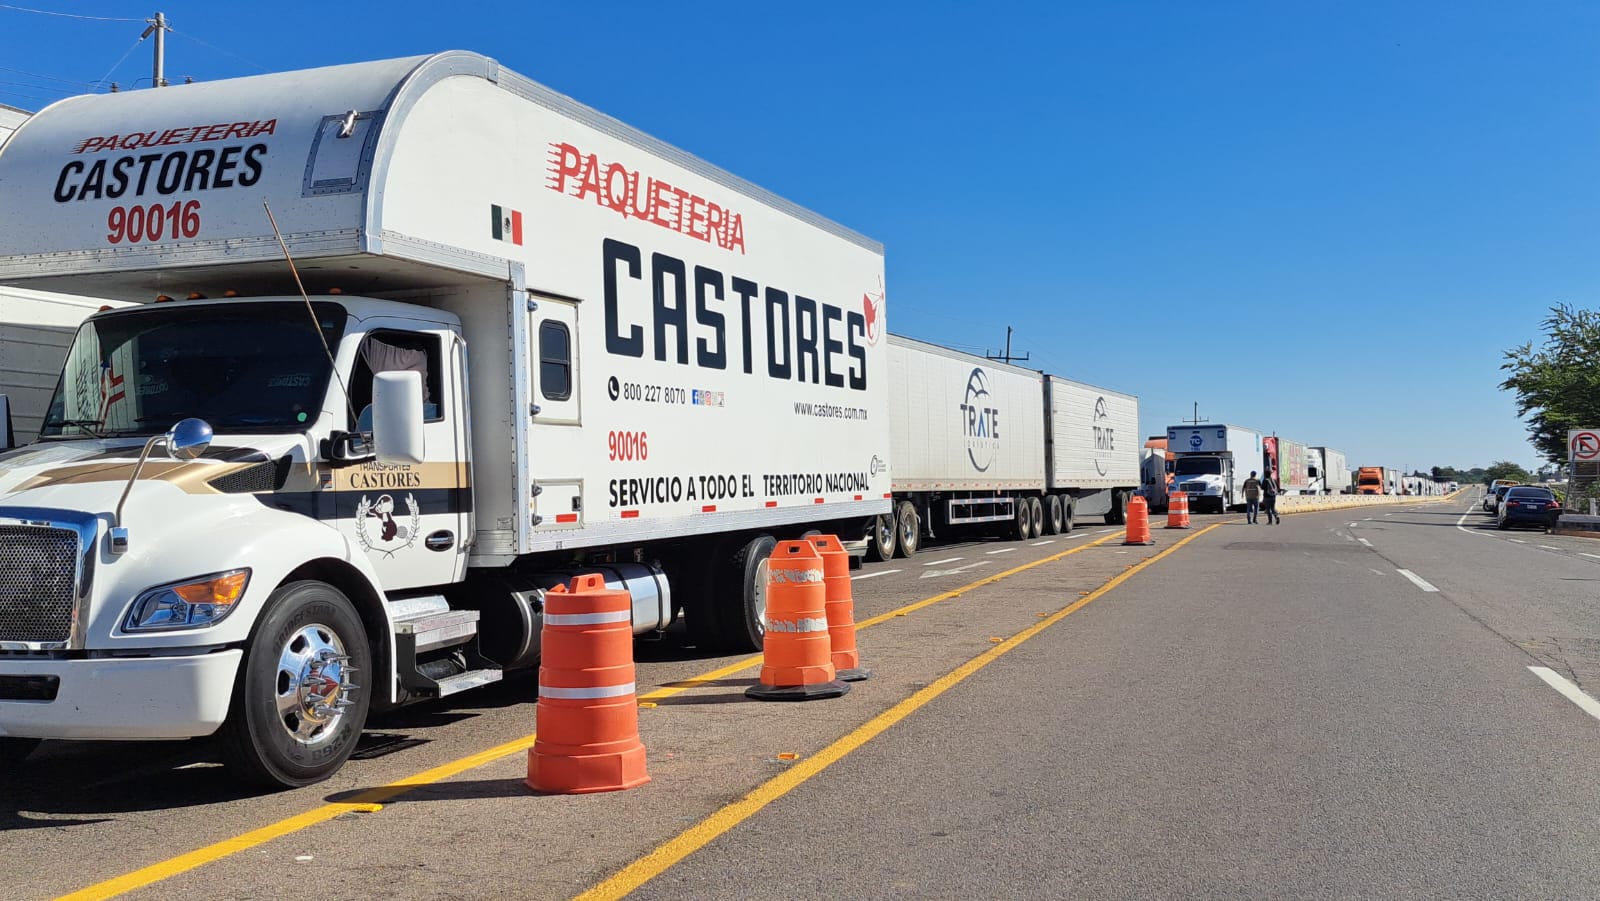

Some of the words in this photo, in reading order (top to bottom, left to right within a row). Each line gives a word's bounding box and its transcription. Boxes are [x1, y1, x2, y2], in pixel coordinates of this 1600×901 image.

[70, 119, 277, 154] PAQUETERIA
[53, 143, 267, 203] CASTORES
[545, 141, 745, 255] PAQUETERIA
[107, 200, 201, 243] 90016
[602, 237, 867, 391] CASTORES
[623, 383, 642, 401] 800
[644, 385, 661, 403] 227
[664, 387, 686, 405] 8070
[794, 401, 868, 420] www.castores.com.mx
[960, 403, 999, 438] TRATE
[608, 430, 648, 461] 90016
[350, 471, 421, 488] CASTORES
[609, 476, 682, 508] SERVICIO
[686, 476, 697, 501] A
[699, 474, 737, 500] TODO
[742, 474, 754, 498] EL
[763, 473, 823, 497] TERRITORIO
[825, 472, 869, 493] NACIONAL
